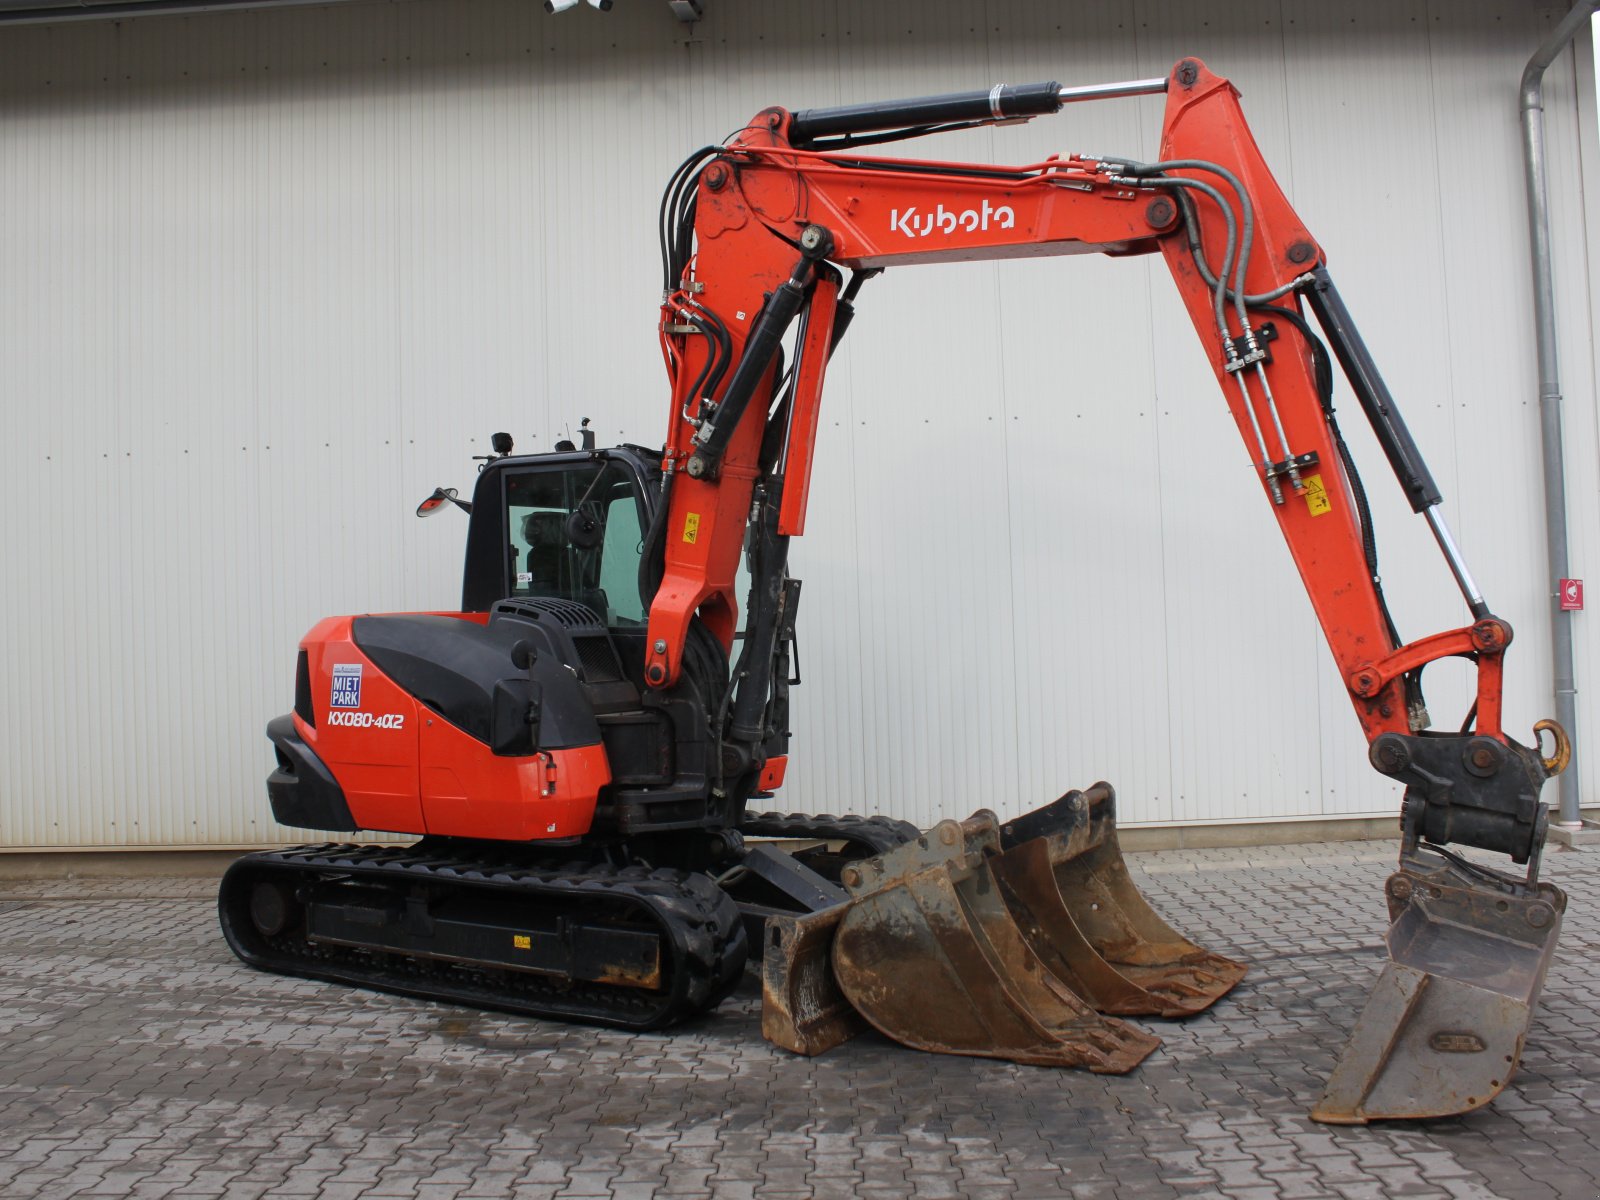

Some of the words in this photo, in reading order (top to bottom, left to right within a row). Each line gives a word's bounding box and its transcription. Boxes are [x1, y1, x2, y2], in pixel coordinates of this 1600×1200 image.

[890, 199, 1015, 238] Kubota
[333, 676, 359, 691] MIET
[332, 691, 358, 705] PARK
